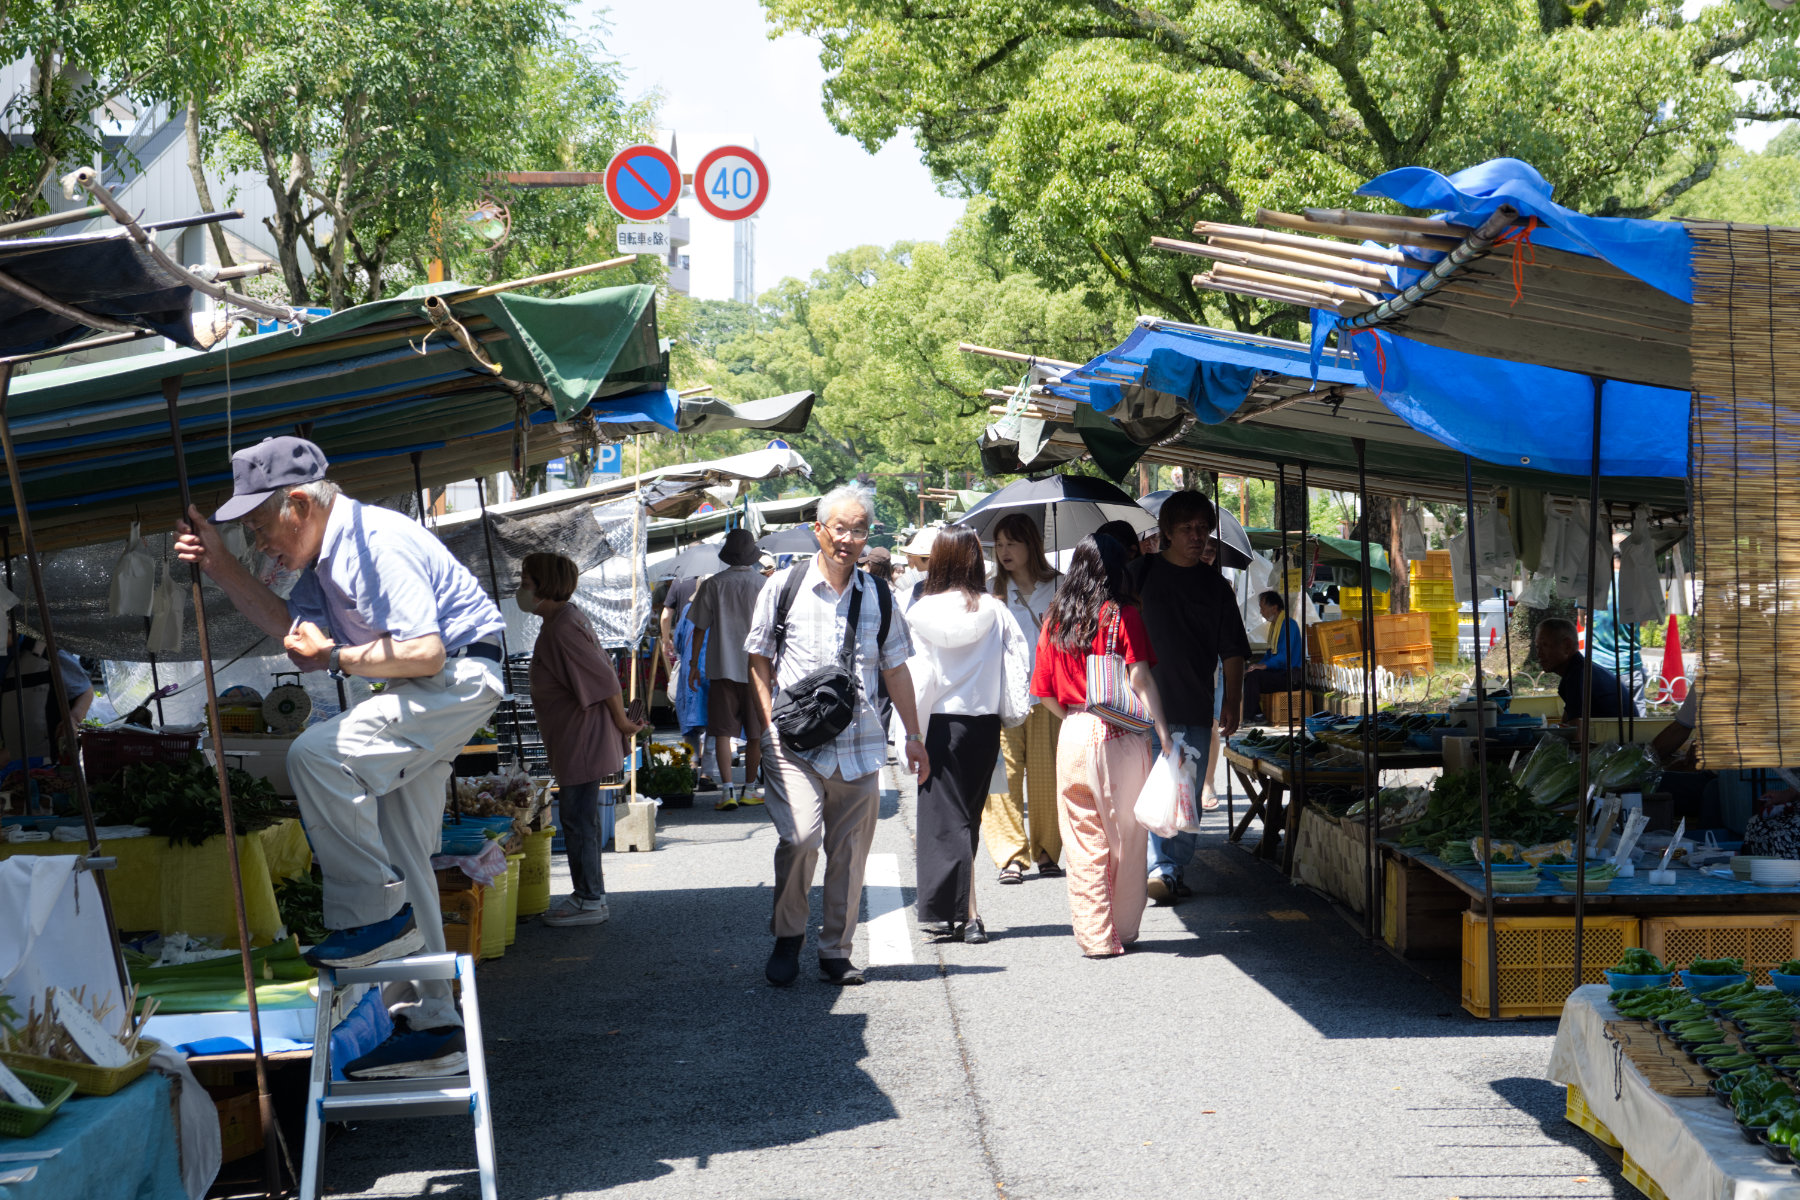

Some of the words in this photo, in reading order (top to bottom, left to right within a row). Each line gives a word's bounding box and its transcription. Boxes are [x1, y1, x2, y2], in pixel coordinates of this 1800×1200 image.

[712, 167, 752, 199] 40
[618, 232, 669, 245] 自転車を除く
[598, 445, 616, 470] P
